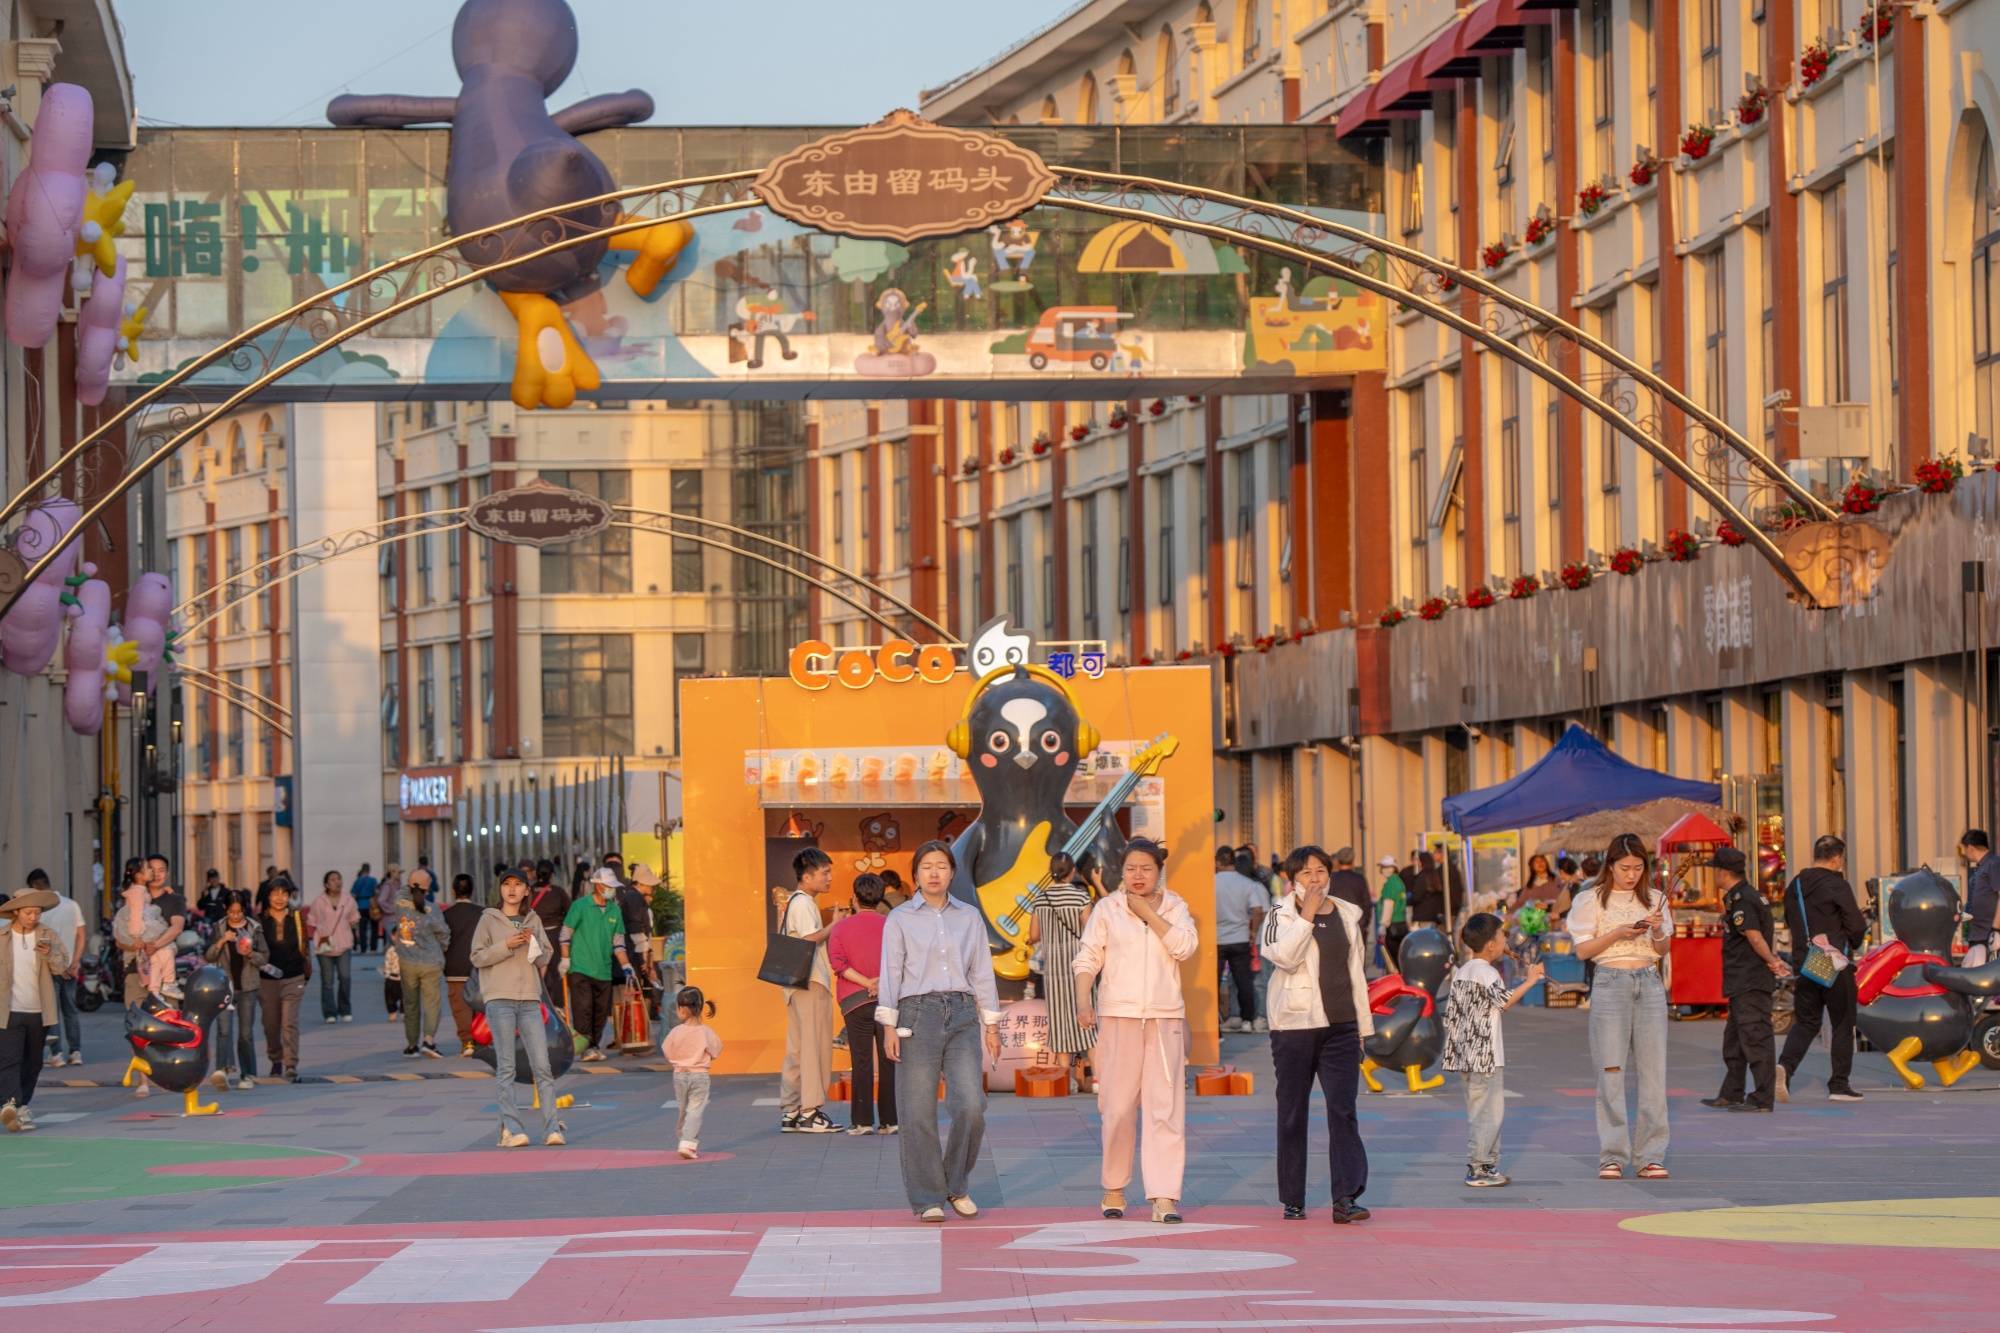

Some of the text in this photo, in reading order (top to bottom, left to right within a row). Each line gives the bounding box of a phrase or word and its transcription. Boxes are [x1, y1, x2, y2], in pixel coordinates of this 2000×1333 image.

[797, 164, 1013, 198] 东由留码头
[483, 507, 595, 524] 东由留码头
[1047, 651, 1106, 680] 都可
